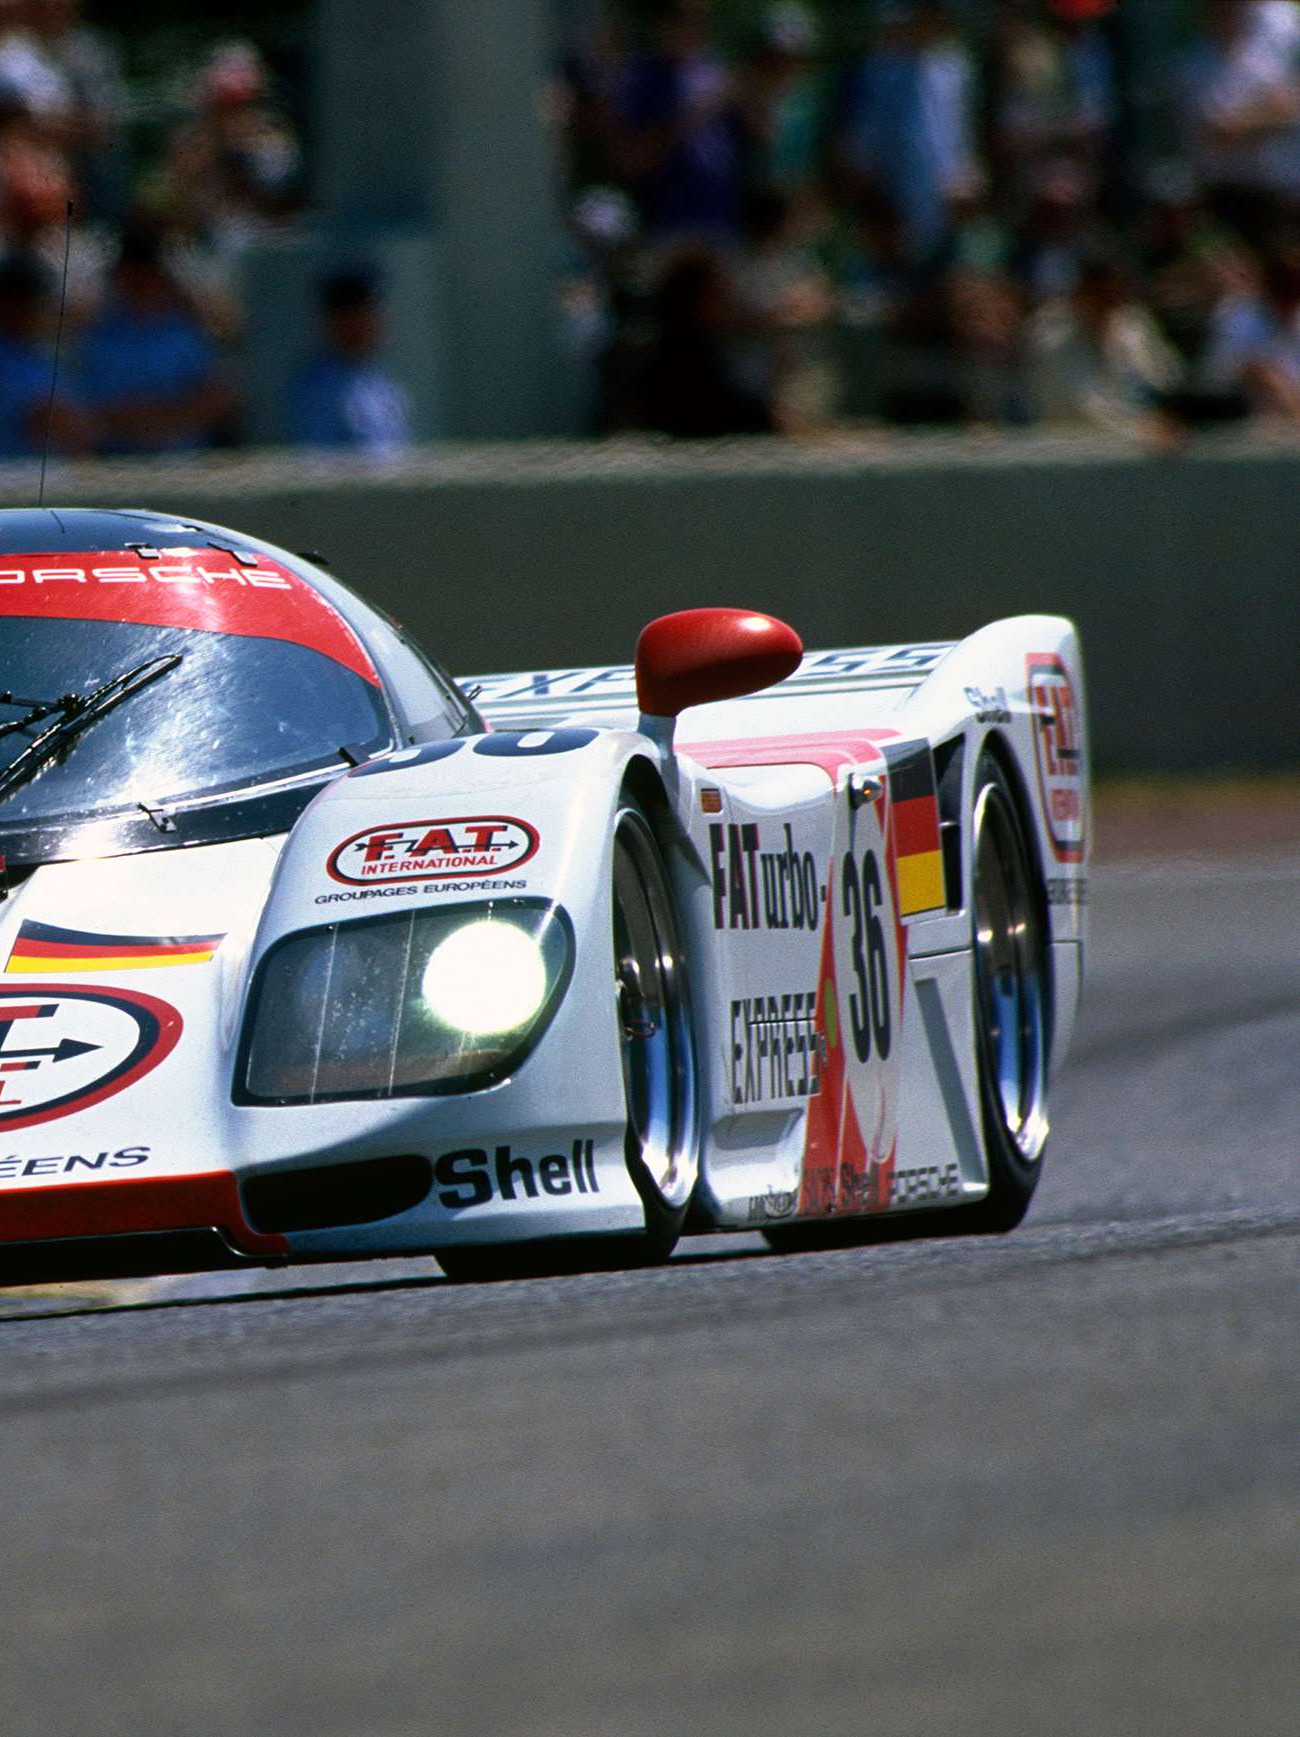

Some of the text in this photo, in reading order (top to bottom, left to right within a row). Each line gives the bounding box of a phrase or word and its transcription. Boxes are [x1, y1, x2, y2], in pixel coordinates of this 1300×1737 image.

[314, 878, 527, 904] GROUPAGES EUROPÉENS
[360, 854, 499, 875] INTERNATIONAL
[842, 849, 891, 1064] 36
[730, 991, 821, 1104] EXPRESS
[435, 1139, 600, 1209] Shell
